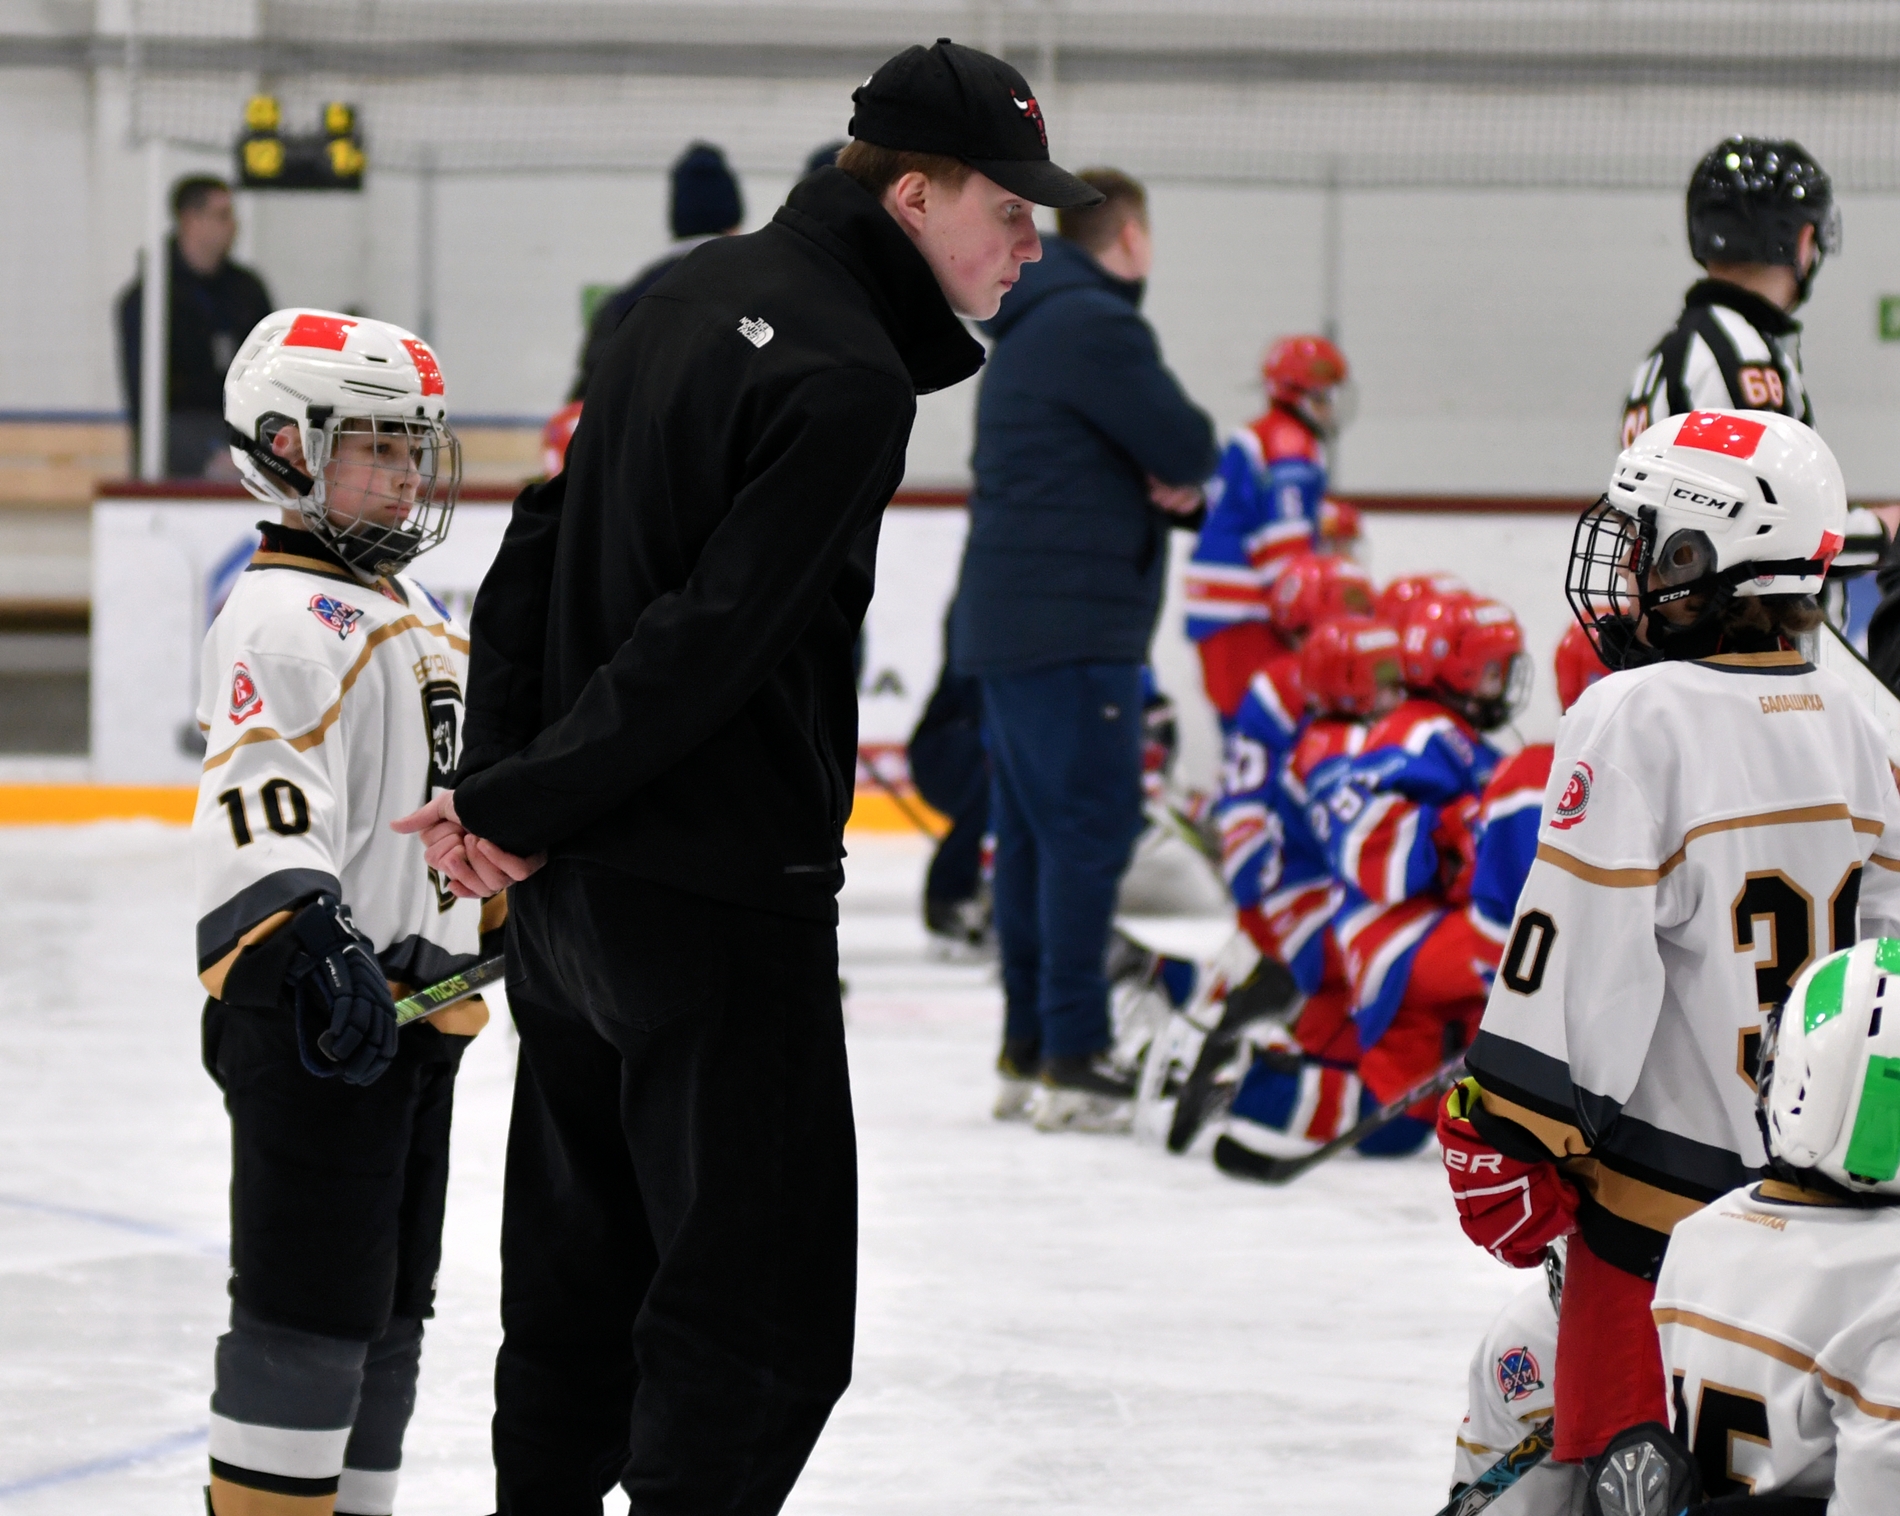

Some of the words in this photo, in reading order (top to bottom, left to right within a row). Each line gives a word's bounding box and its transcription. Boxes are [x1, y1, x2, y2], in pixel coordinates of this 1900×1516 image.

[738, 316, 762, 335] NORTH
[1673, 488, 1728, 510] CCM
[1659, 589, 1690, 603] CCM
[1759, 694, 1825, 714] БАЛАШИХА
[217, 777, 311, 849] 10
[422, 975, 470, 1003] TACKS
[1730, 860, 1862, 1100] 3
[1503, 1369, 1534, 1390] ФХМ
